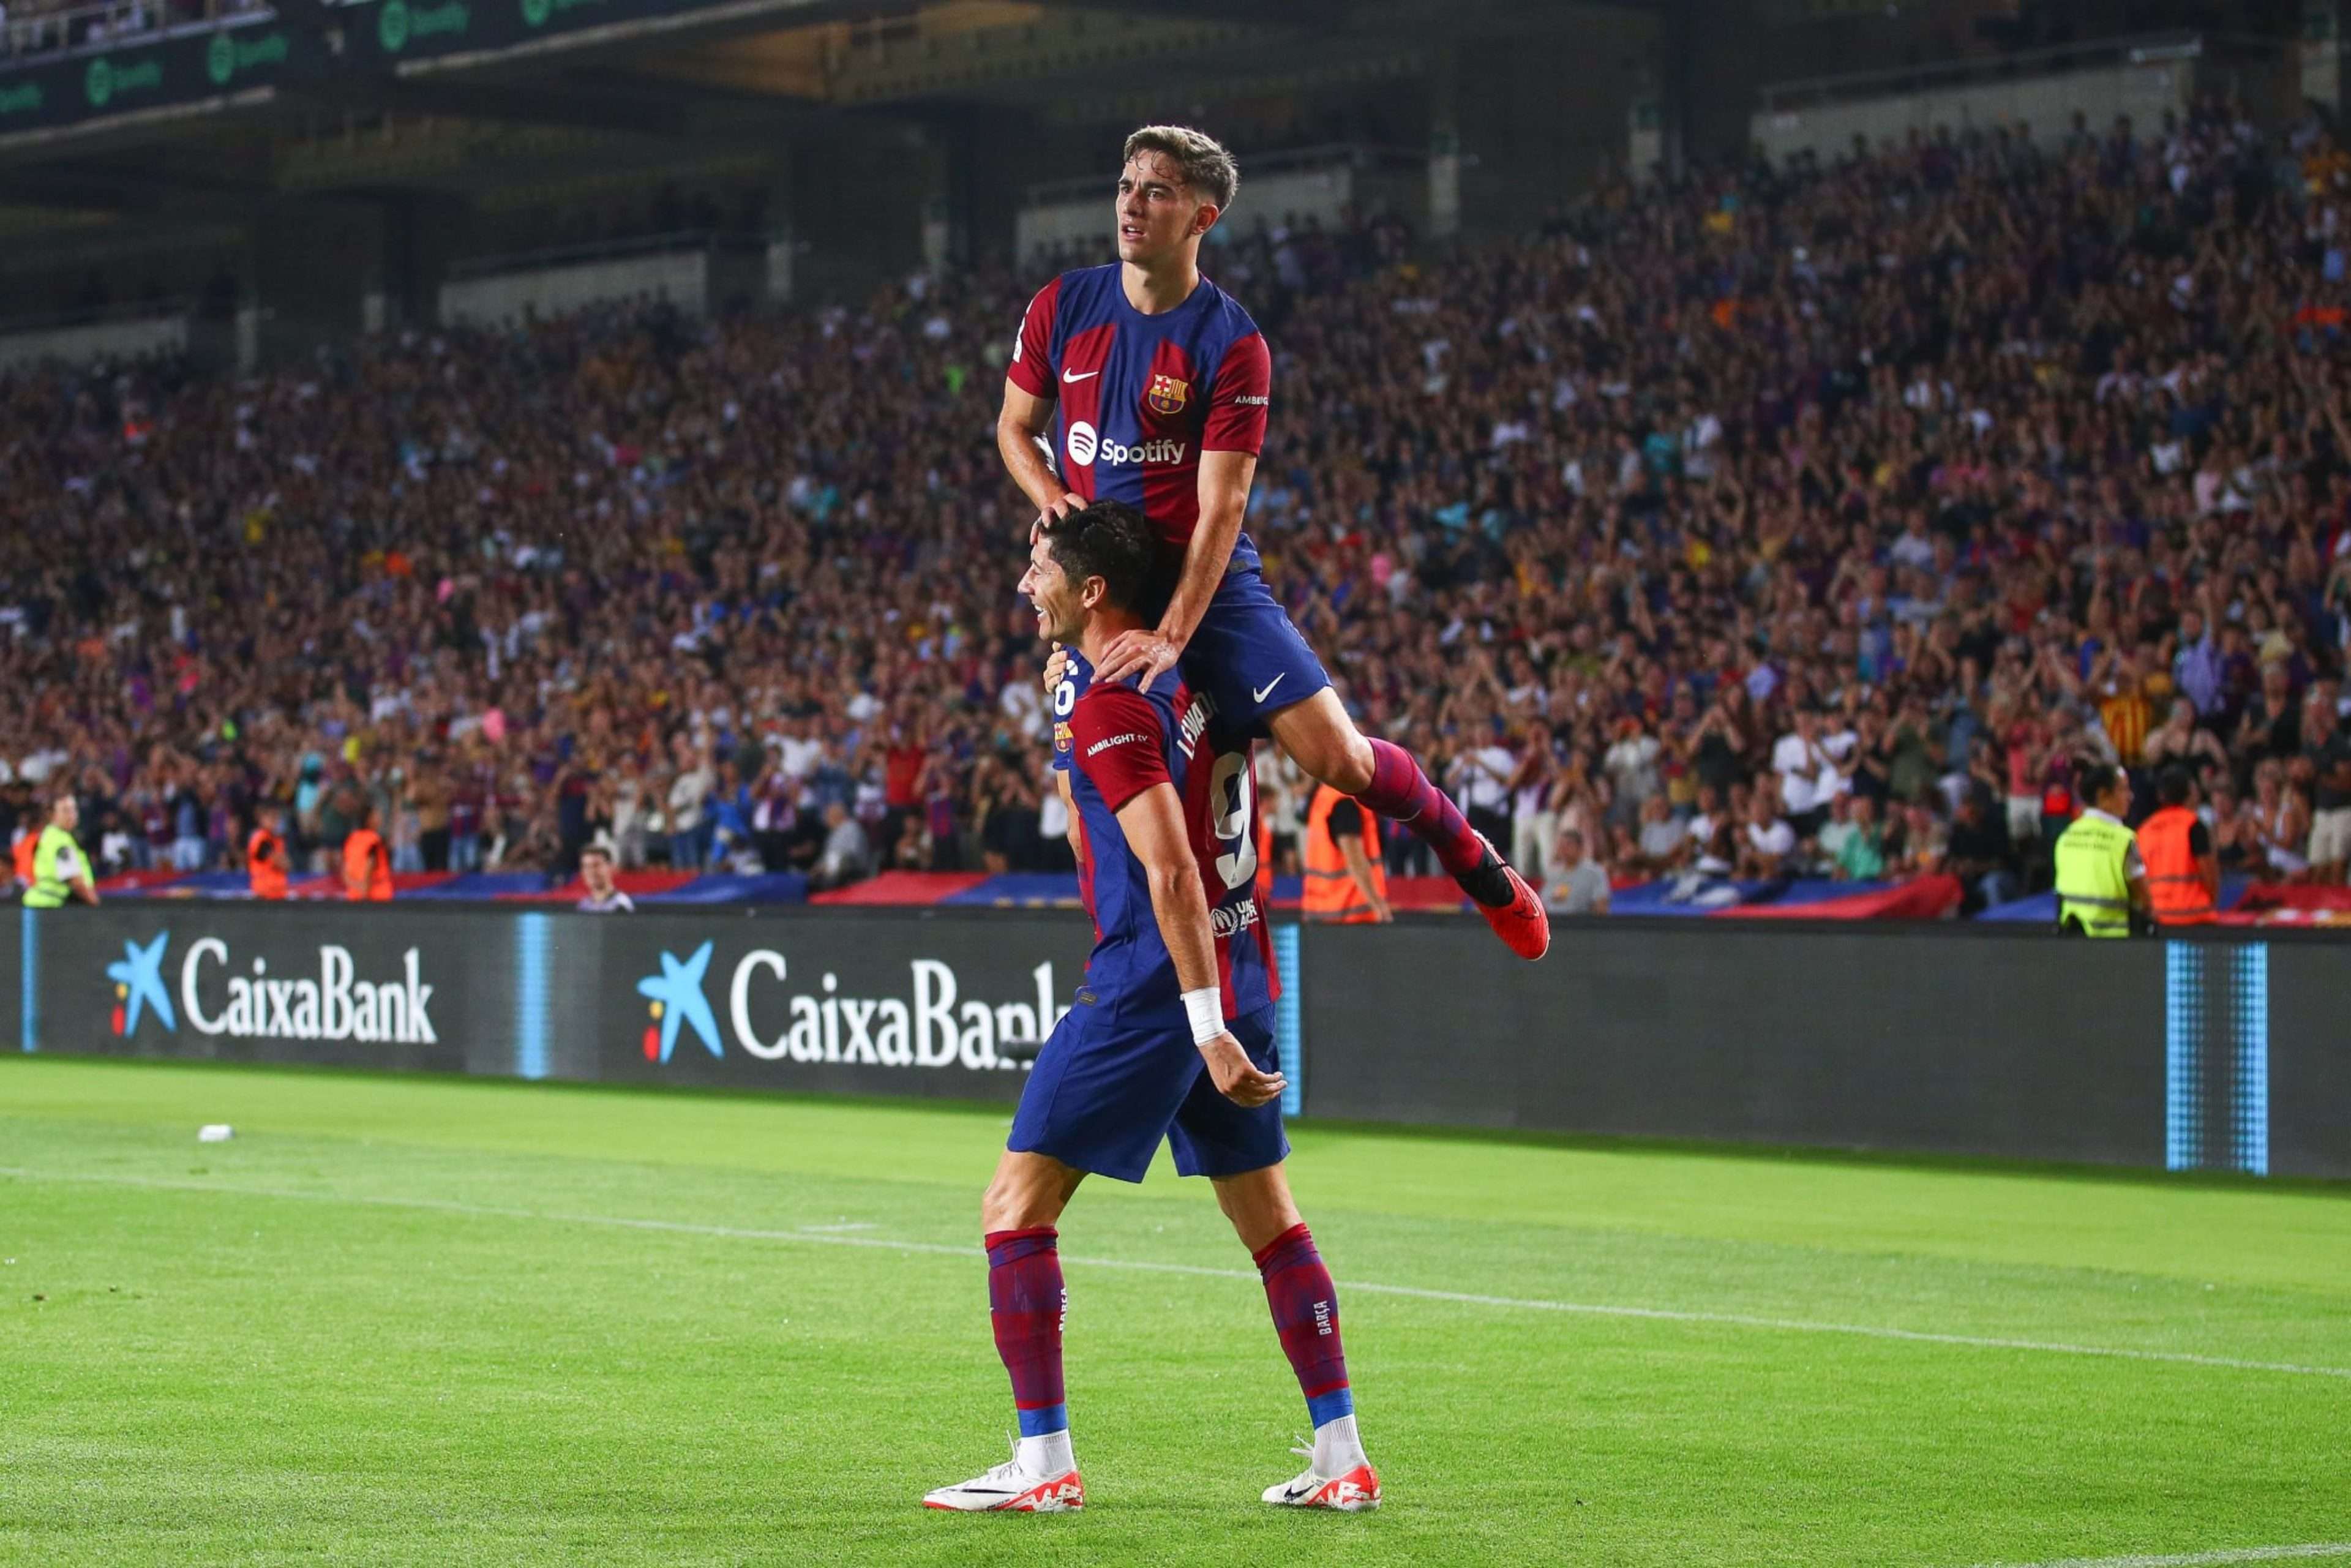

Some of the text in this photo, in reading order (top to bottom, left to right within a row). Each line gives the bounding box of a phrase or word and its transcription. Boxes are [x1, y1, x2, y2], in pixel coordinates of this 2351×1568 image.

[1100, 438, 1185, 467] Spotify
[1087, 733, 1135, 757] AMBILIGHT
[1210, 751, 1257, 890] 9
[181, 937, 437, 1044] CaixaBank
[1313, 1300, 1332, 1335] BARÇA
